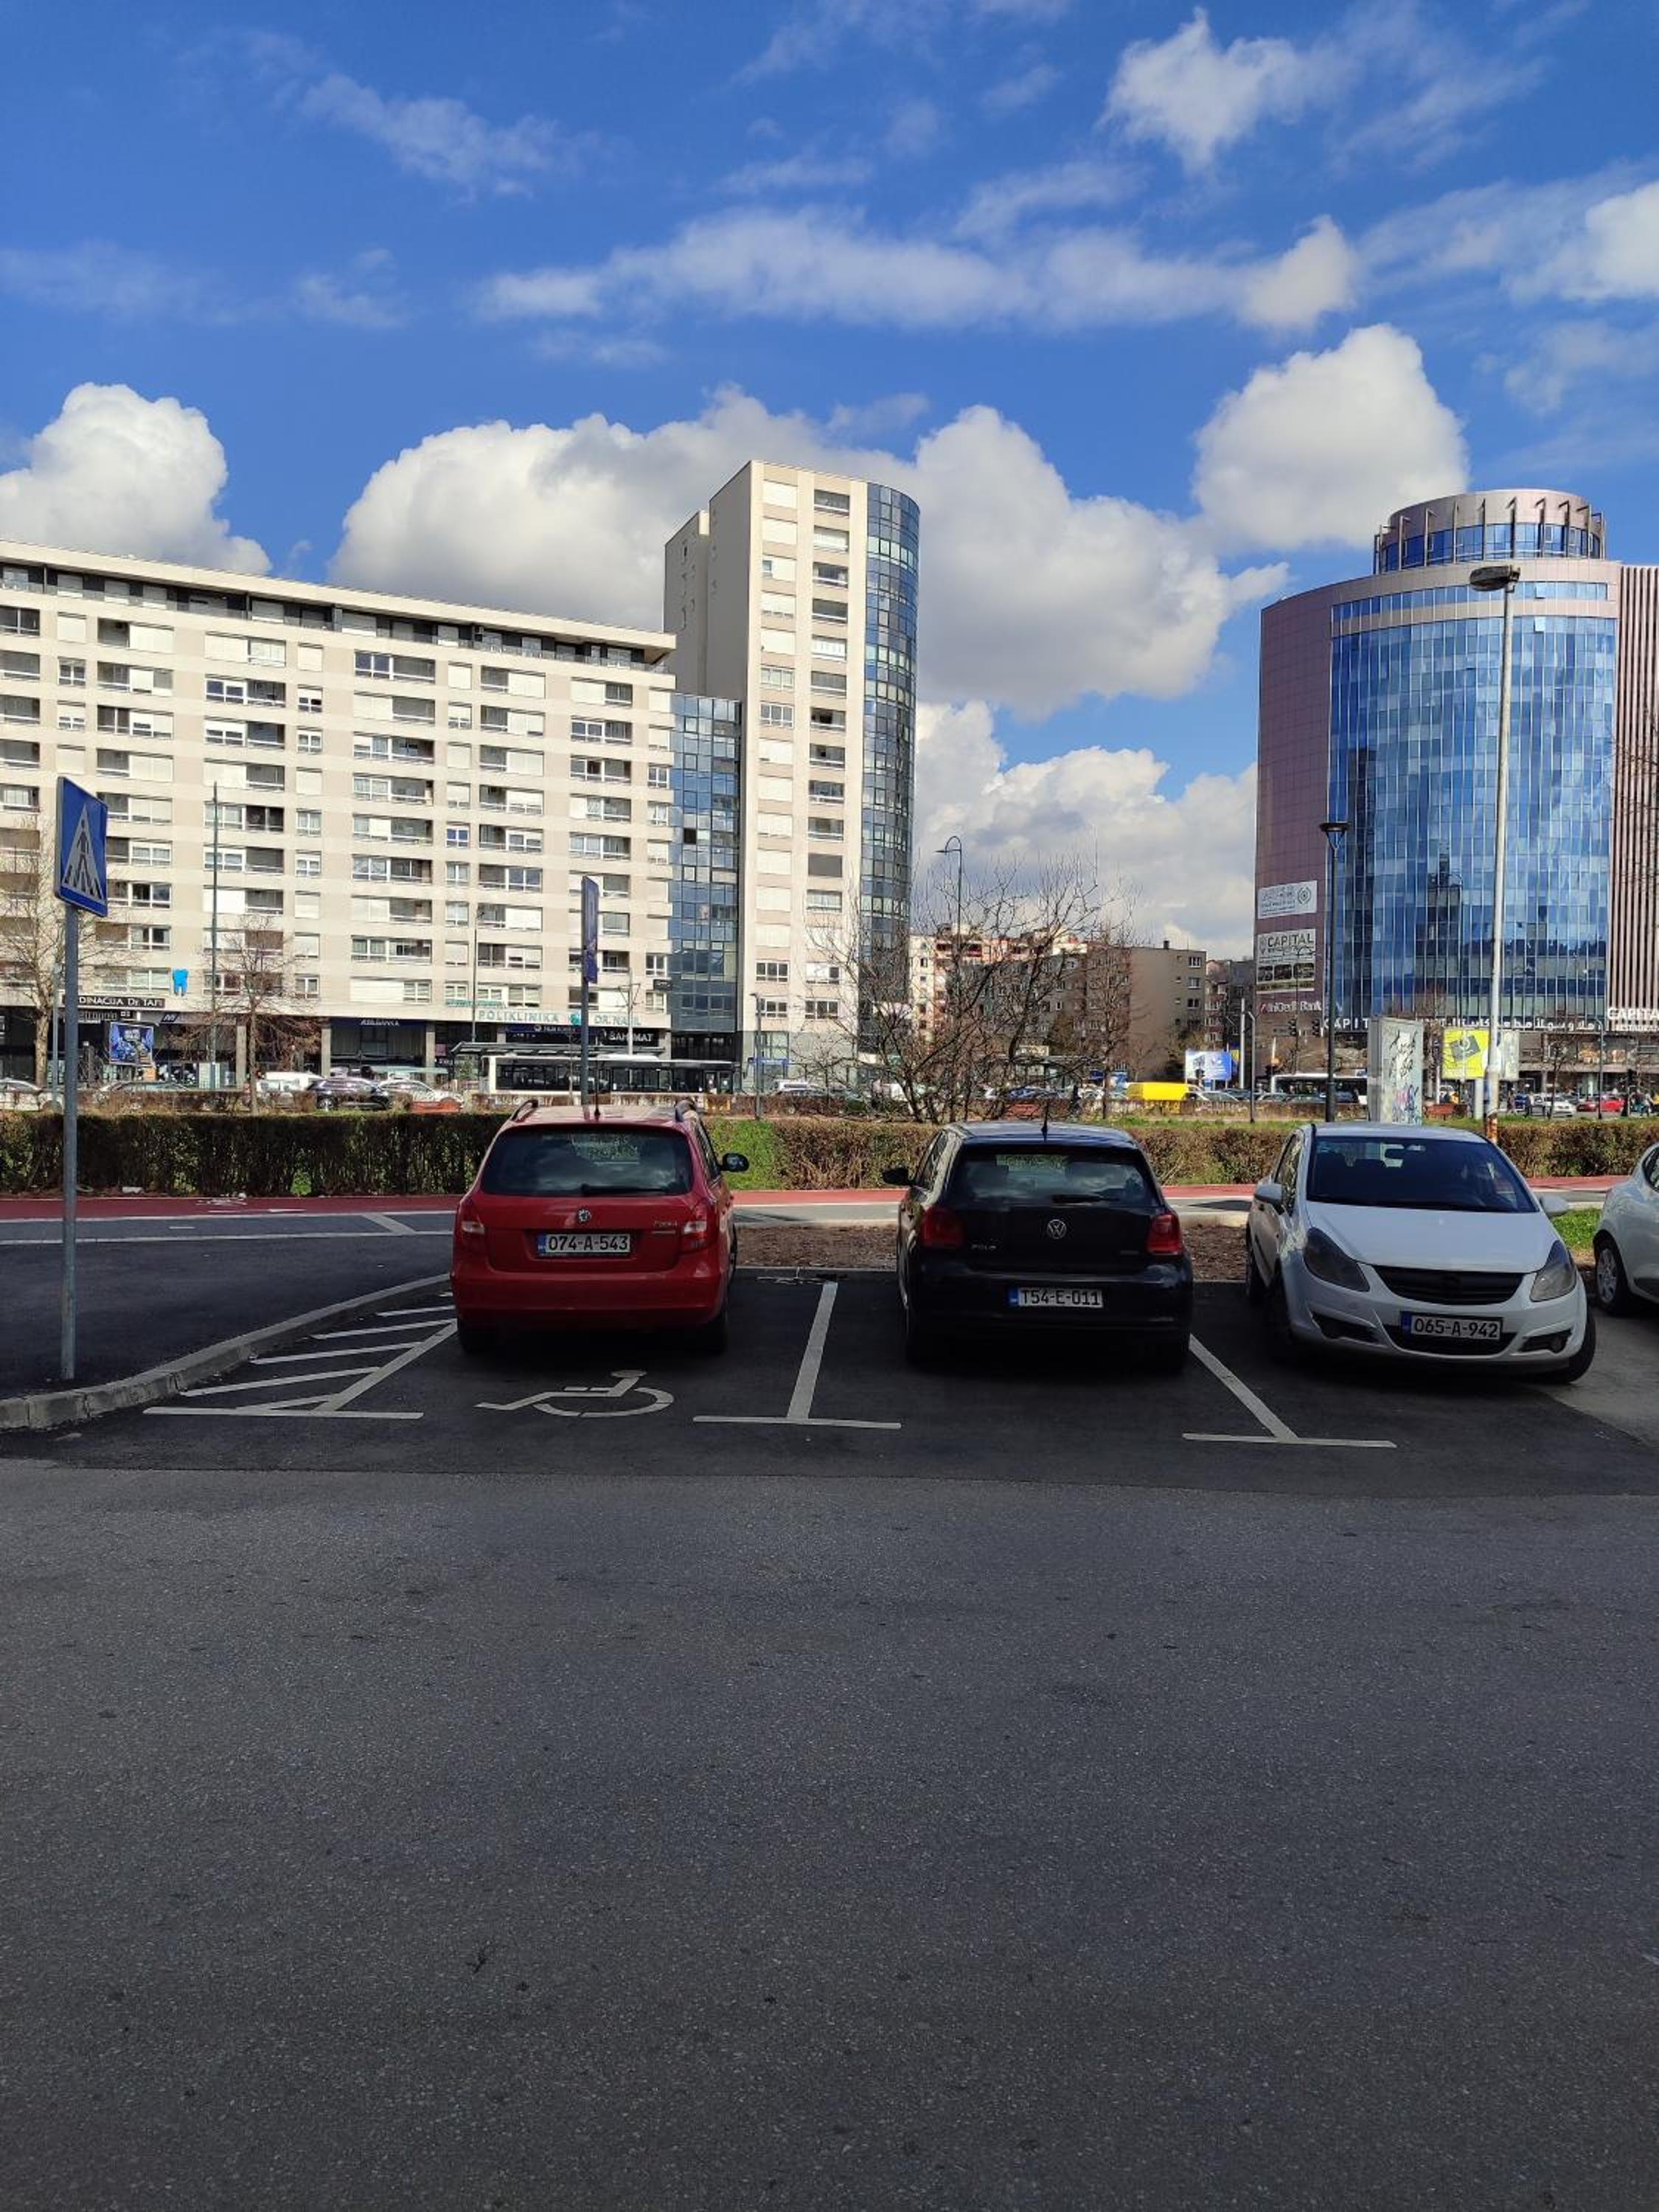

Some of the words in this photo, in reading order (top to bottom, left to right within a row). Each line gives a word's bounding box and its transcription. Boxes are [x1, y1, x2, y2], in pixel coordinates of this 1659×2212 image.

[1267, 933, 1315, 947] CAPITAL
[79, 997, 124, 1005] DINACIJA
[479, 1009, 559, 1022] POLIKLINIKA
[1020, 1290, 1100, 1305] T54-E-011
